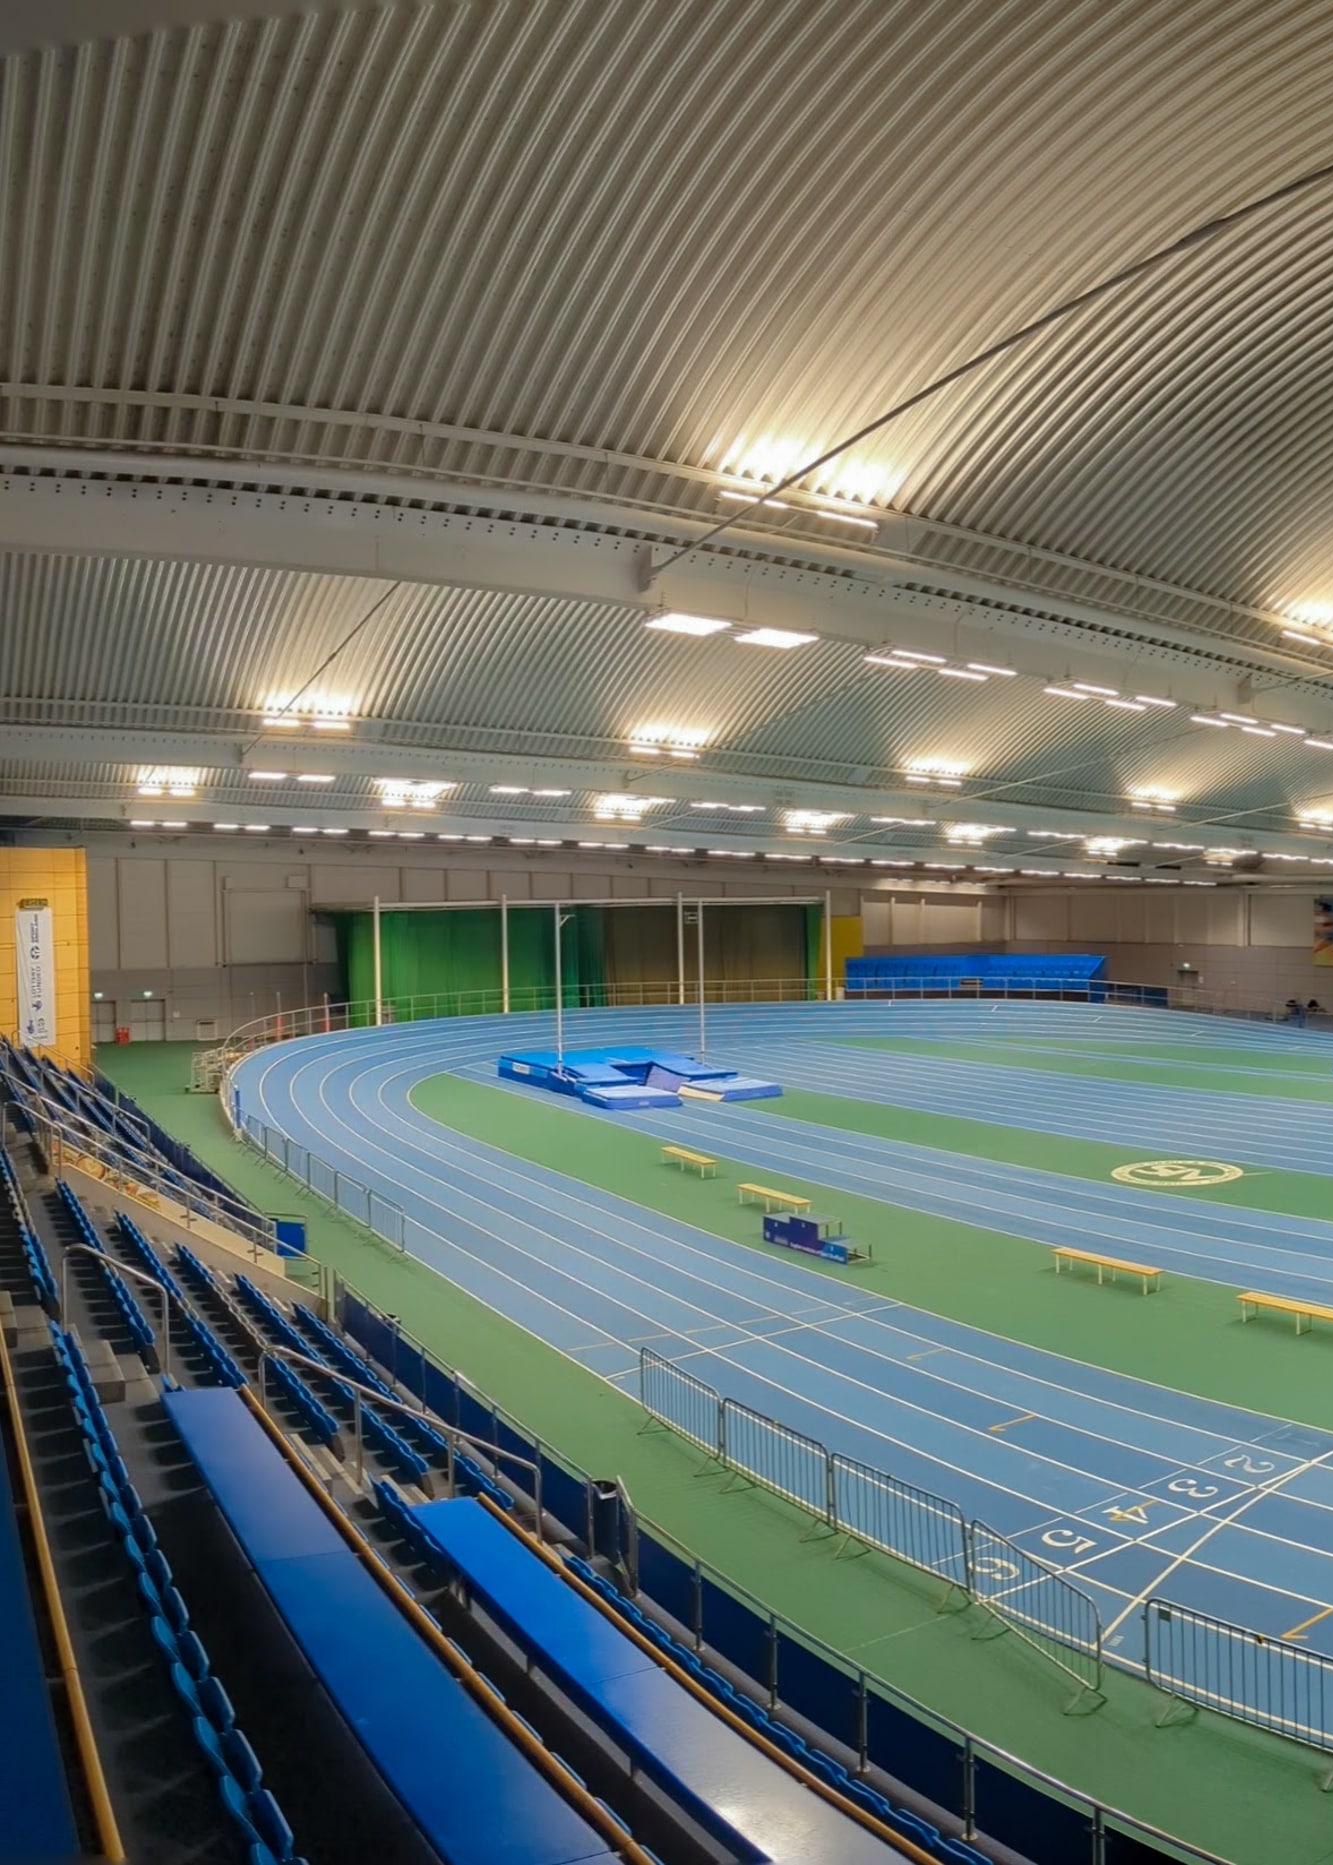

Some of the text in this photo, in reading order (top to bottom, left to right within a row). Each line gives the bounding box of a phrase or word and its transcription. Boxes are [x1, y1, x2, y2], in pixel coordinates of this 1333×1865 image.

[1224, 1454, 1275, 1473] 2
[1168, 1478, 1218, 1498] 3
[1102, 1505, 1149, 1524] 4
[1041, 1529, 1098, 1554] 5
